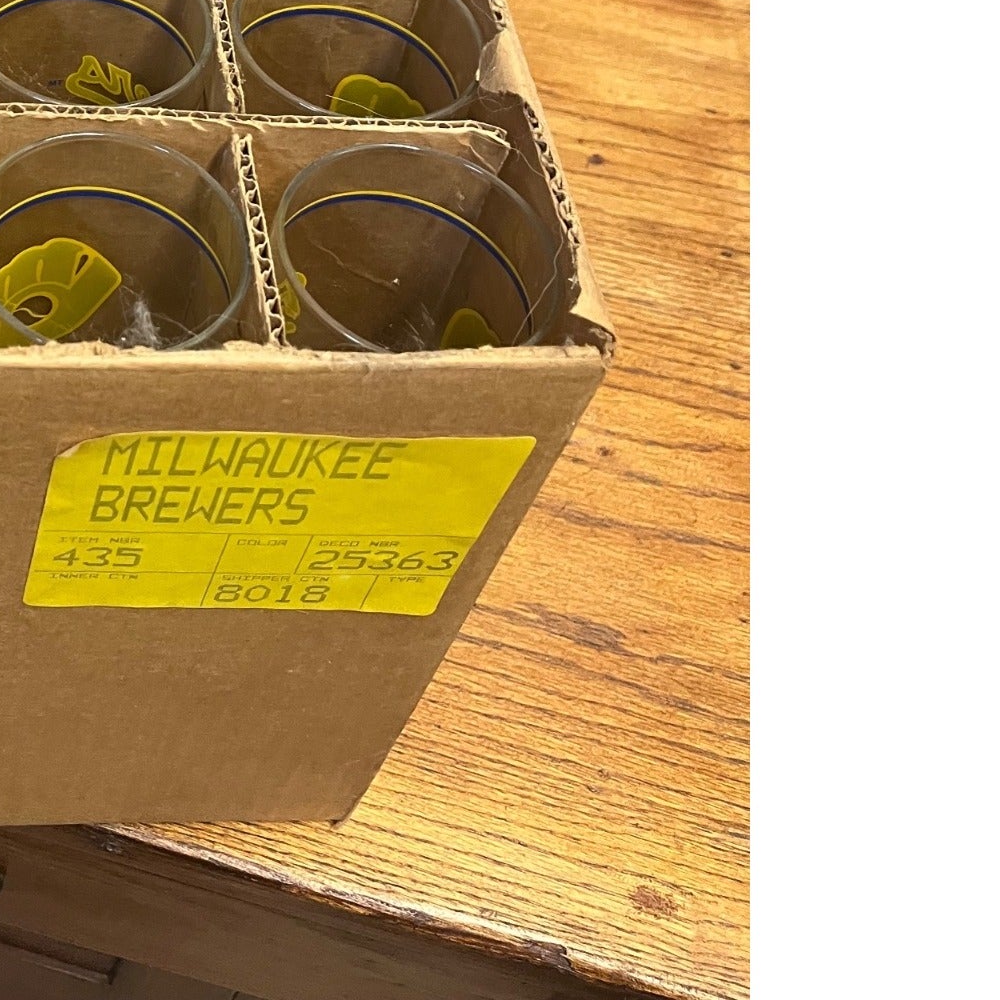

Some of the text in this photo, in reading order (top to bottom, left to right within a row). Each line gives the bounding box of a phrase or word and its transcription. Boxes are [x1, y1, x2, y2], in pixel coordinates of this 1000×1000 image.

[102, 436, 408, 480] MILWAUKEE
[89, 484, 316, 525] BREWERS
[59, 536, 99, 544] ITEM
[236, 539, 288, 547] COLOR
[53, 547, 143, 567] 435
[307, 550, 459, 571] 25363
[388, 576, 426, 584] TYPE
[213, 584, 331, 604] 8018
